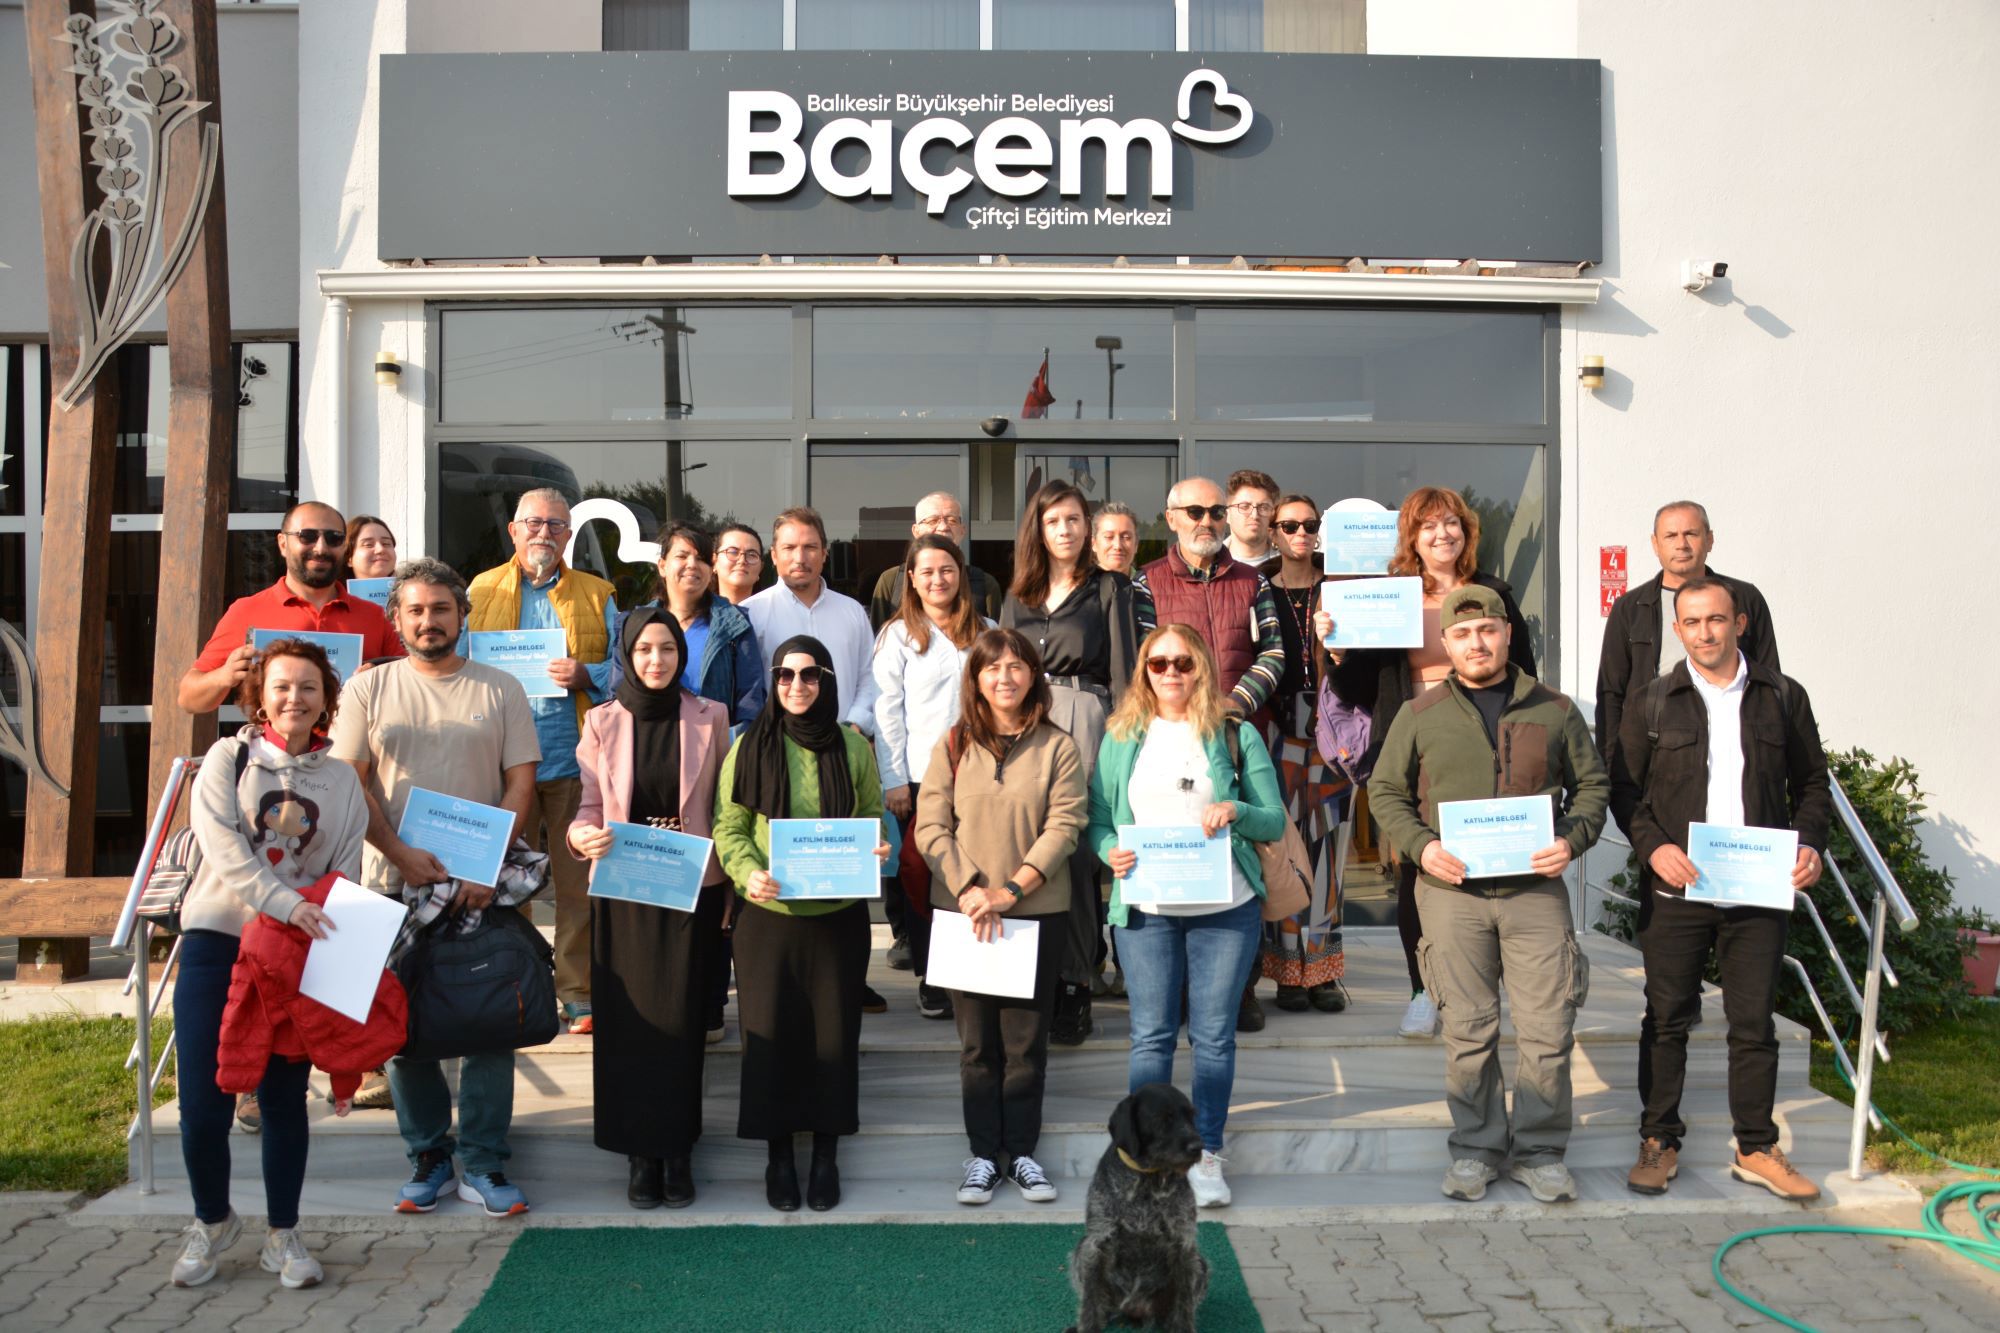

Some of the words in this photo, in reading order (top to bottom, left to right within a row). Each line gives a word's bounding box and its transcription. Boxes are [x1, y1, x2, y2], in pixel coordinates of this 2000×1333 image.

[807, 92, 892, 112] Balıkesir
[896, 92, 1007, 117] Büyükşehir
[1011, 92, 1114, 117] Belediyesi
[727, 90, 1173, 214] Baçem
[965, 206, 1020, 230] Çiftçi
[1025, 206, 1089, 230] Eğitim
[1094, 206, 1172, 226] Merkezi
[1609, 552, 1618, 570] 4
[518, 642, 546, 651] BELGESİ
[428, 808, 457, 821] KATILIM
[458, 815, 489, 829] BELGESİ
[1463, 816, 1494, 824] KATILIM
[1495, 812, 1527, 822] BELGESİ
[824, 834, 856, 843] BELGESİ
[1142, 841, 1173, 849] KATILIM
[1174, 841, 1206, 849] BELGESİ
[1709, 840, 1738, 849] KATILIM
[1739, 843, 1771, 853] BELGESİ
[623, 839, 653, 851] KATILIM
[654, 845, 686, 857] BELGESİ
